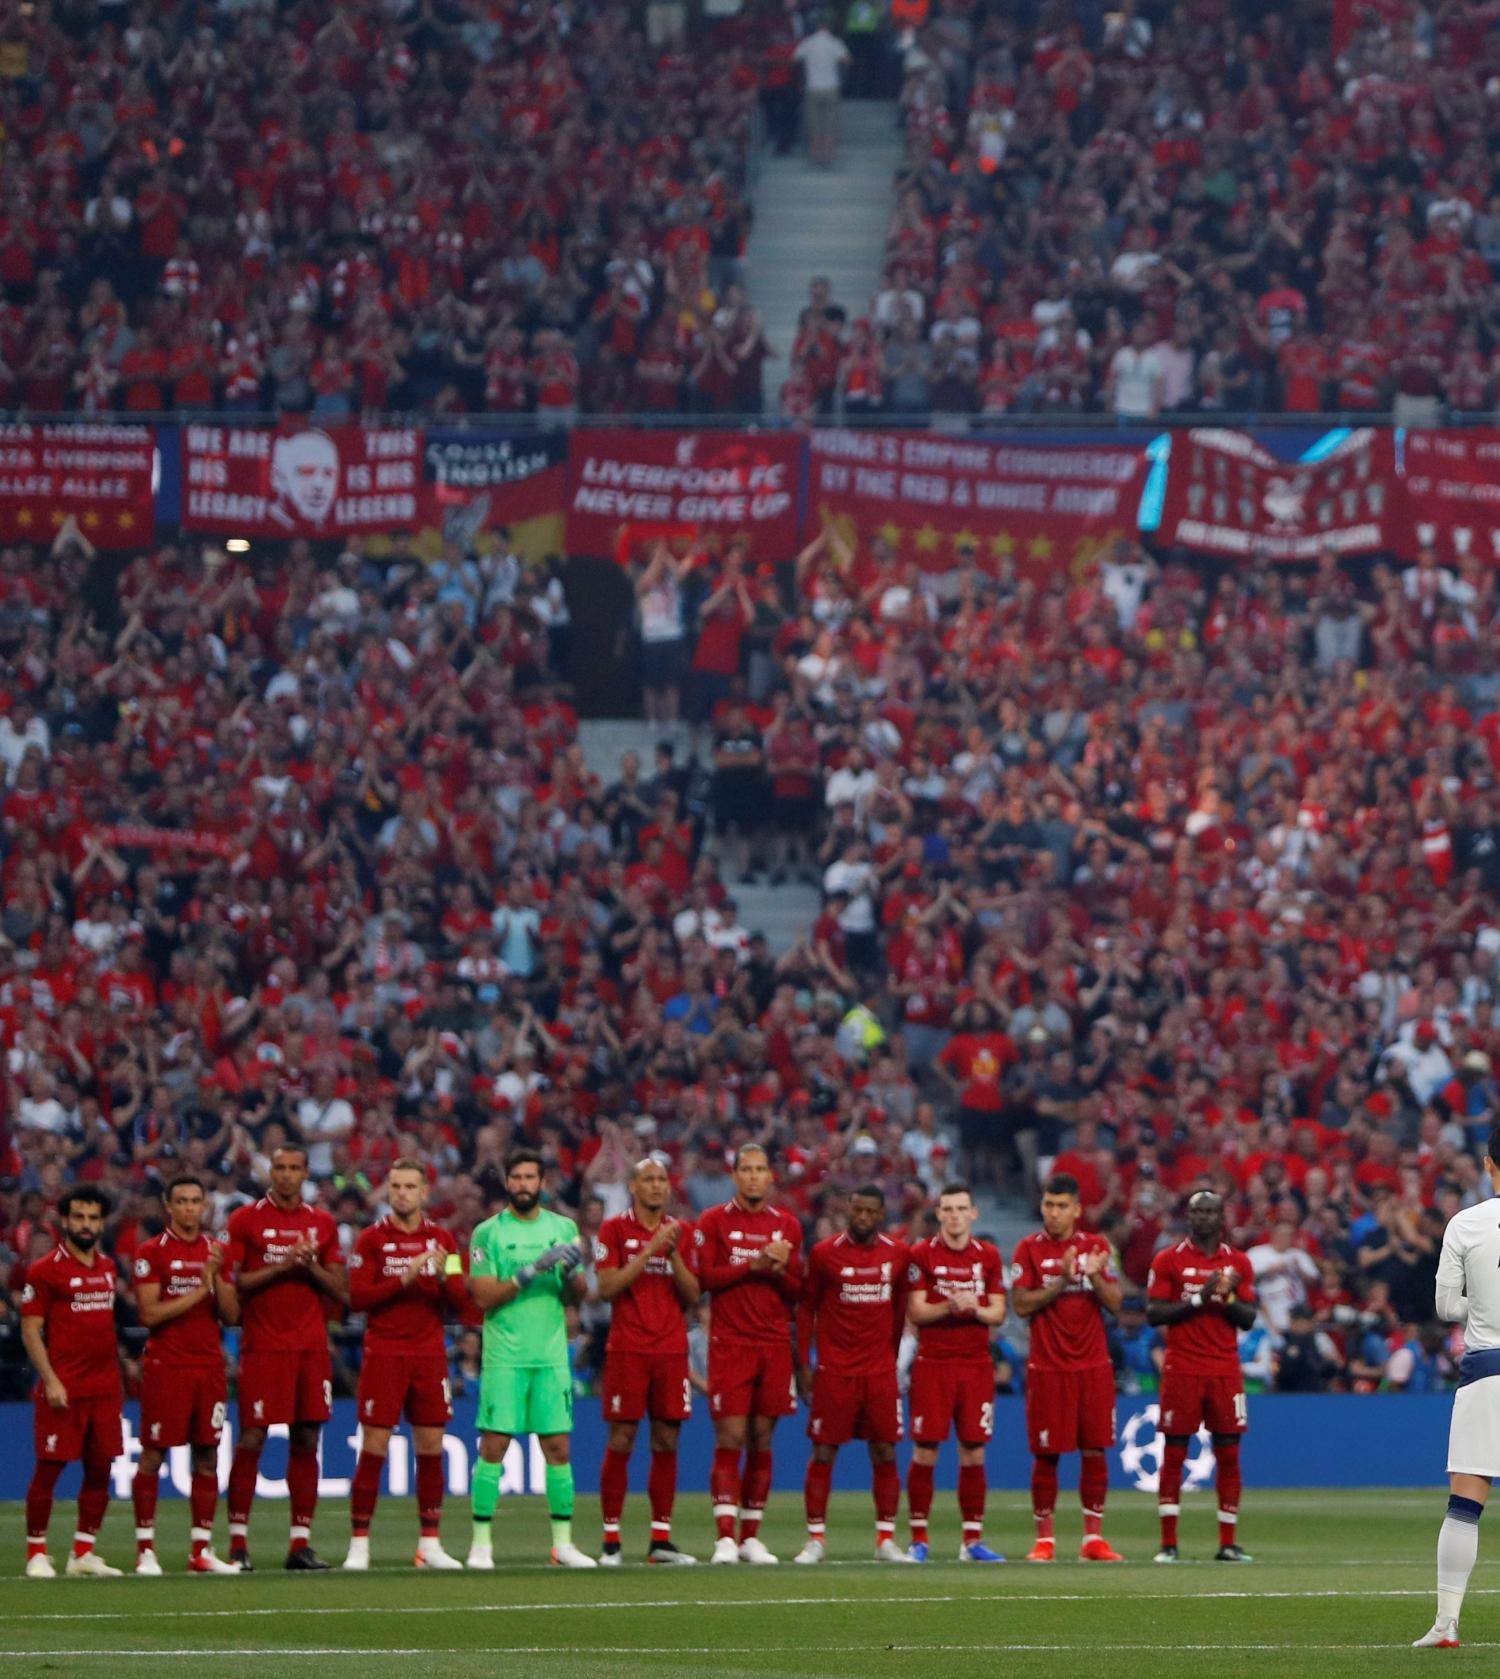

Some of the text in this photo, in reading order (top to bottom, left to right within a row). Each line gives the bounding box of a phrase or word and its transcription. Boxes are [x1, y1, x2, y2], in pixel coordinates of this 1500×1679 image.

[187, 425, 270, 457] WE ARE
[366, 428, 416, 460] THIS
[188, 457, 227, 485] HIS
[347, 460, 415, 492] IS HIS
[582, 456, 786, 494] LIVERPOOL FC
[189, 489, 266, 522] LEGACY
[335, 493, 415, 526] LEGEND
[573, 487, 791, 522] NEVER GIVE UP
[840, 1292, 881, 1304] Chartered
[842, 1282, 881, 1293] Standard
